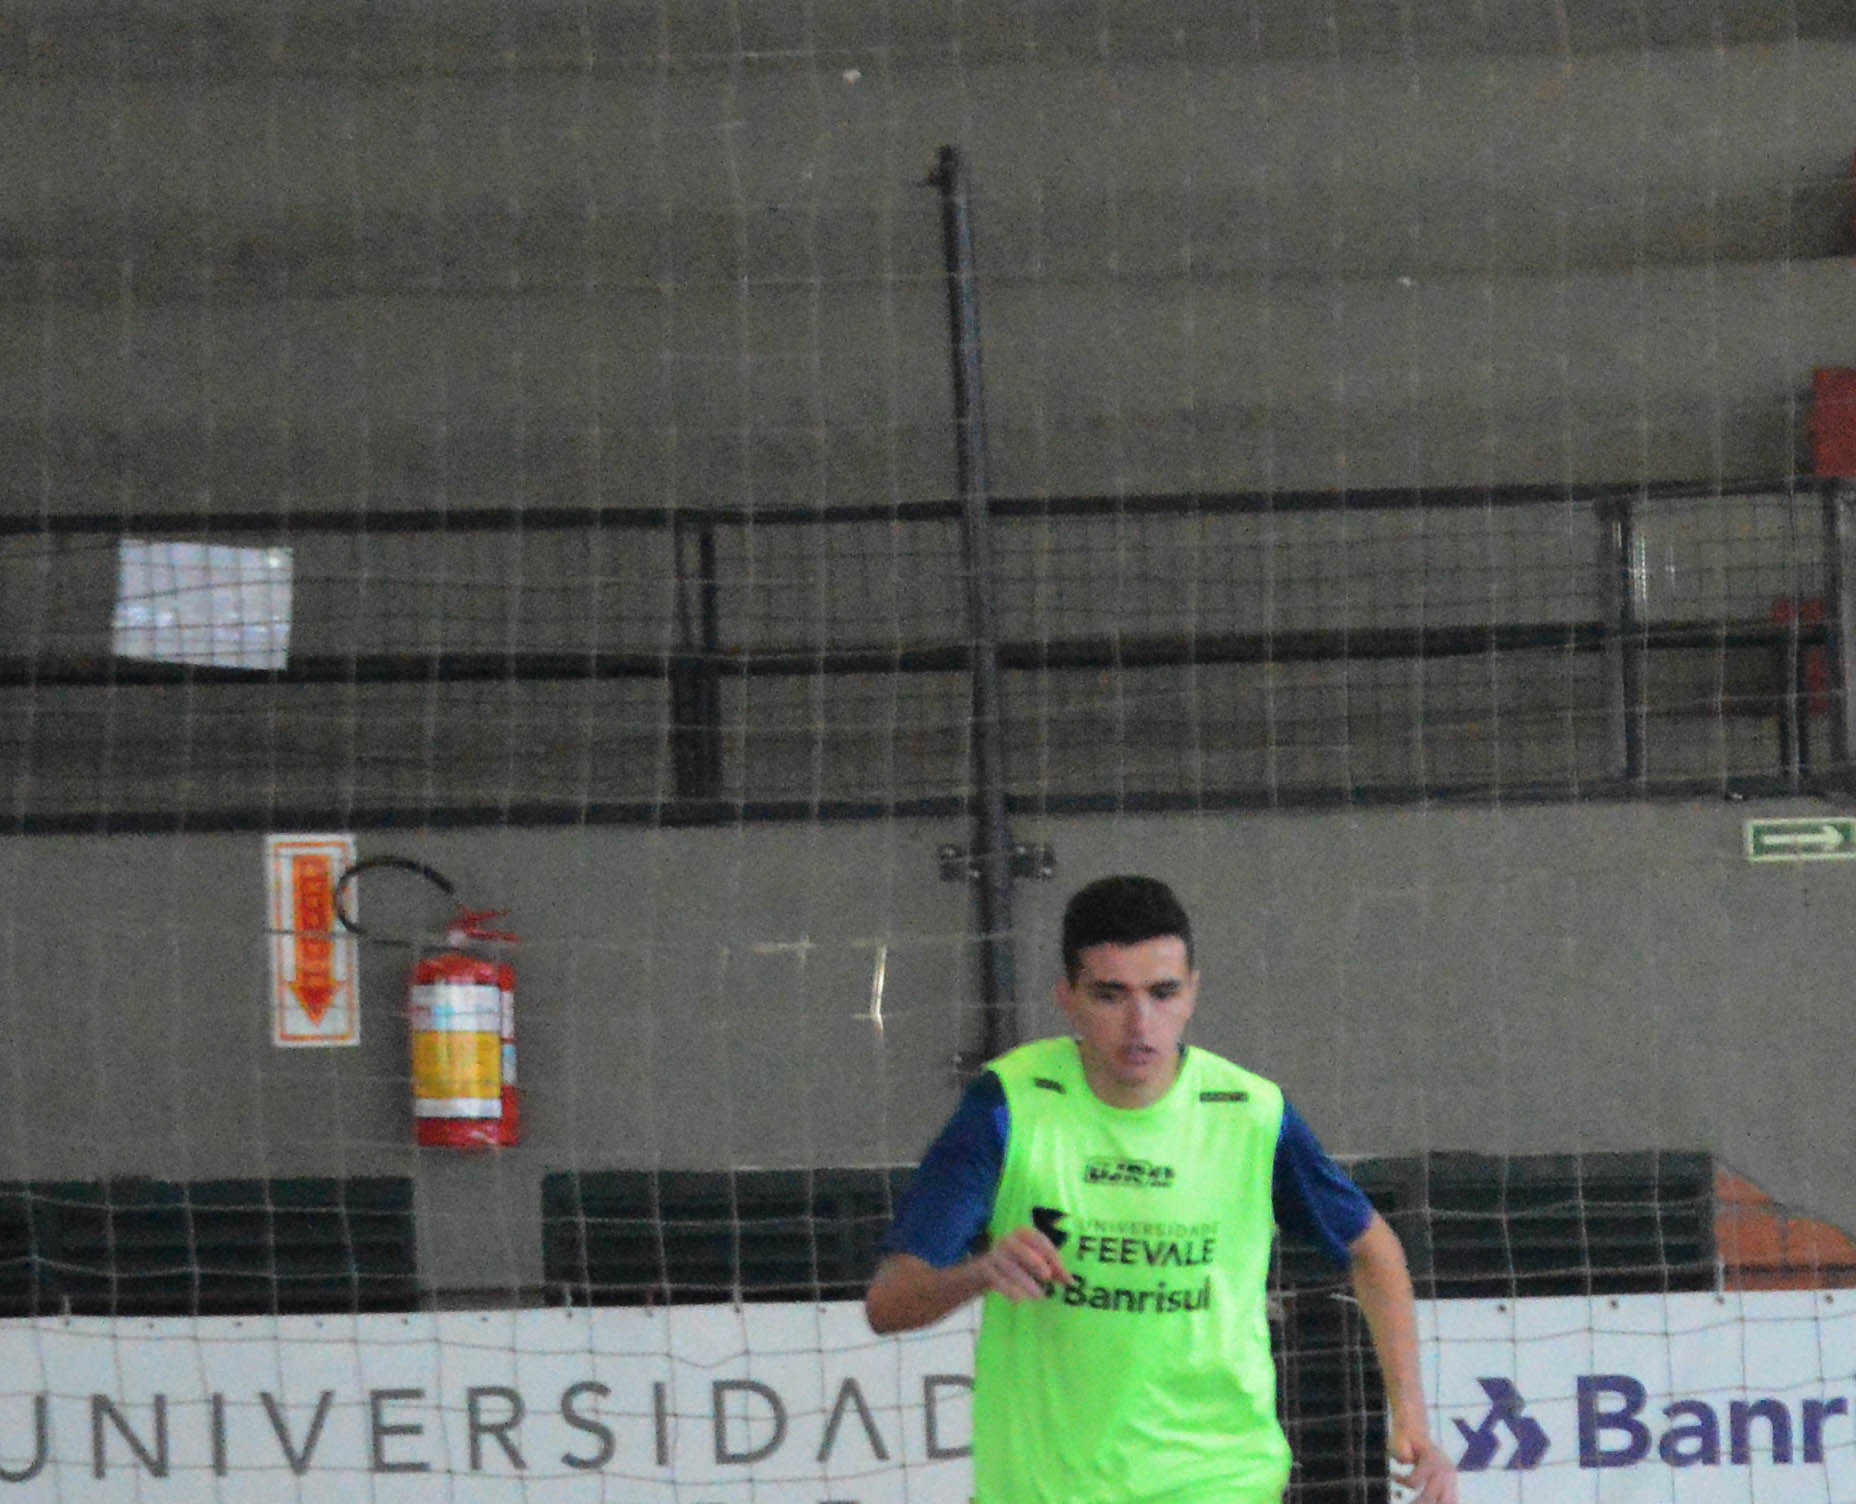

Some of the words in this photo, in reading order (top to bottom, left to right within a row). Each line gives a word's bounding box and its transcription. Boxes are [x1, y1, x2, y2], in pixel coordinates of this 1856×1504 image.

[1076, 1235, 1216, 1267] FEEVALE
[1062, 1272, 1212, 1314] Banrisul
[0, 1372, 975, 1483] UNIVERSIDAD
